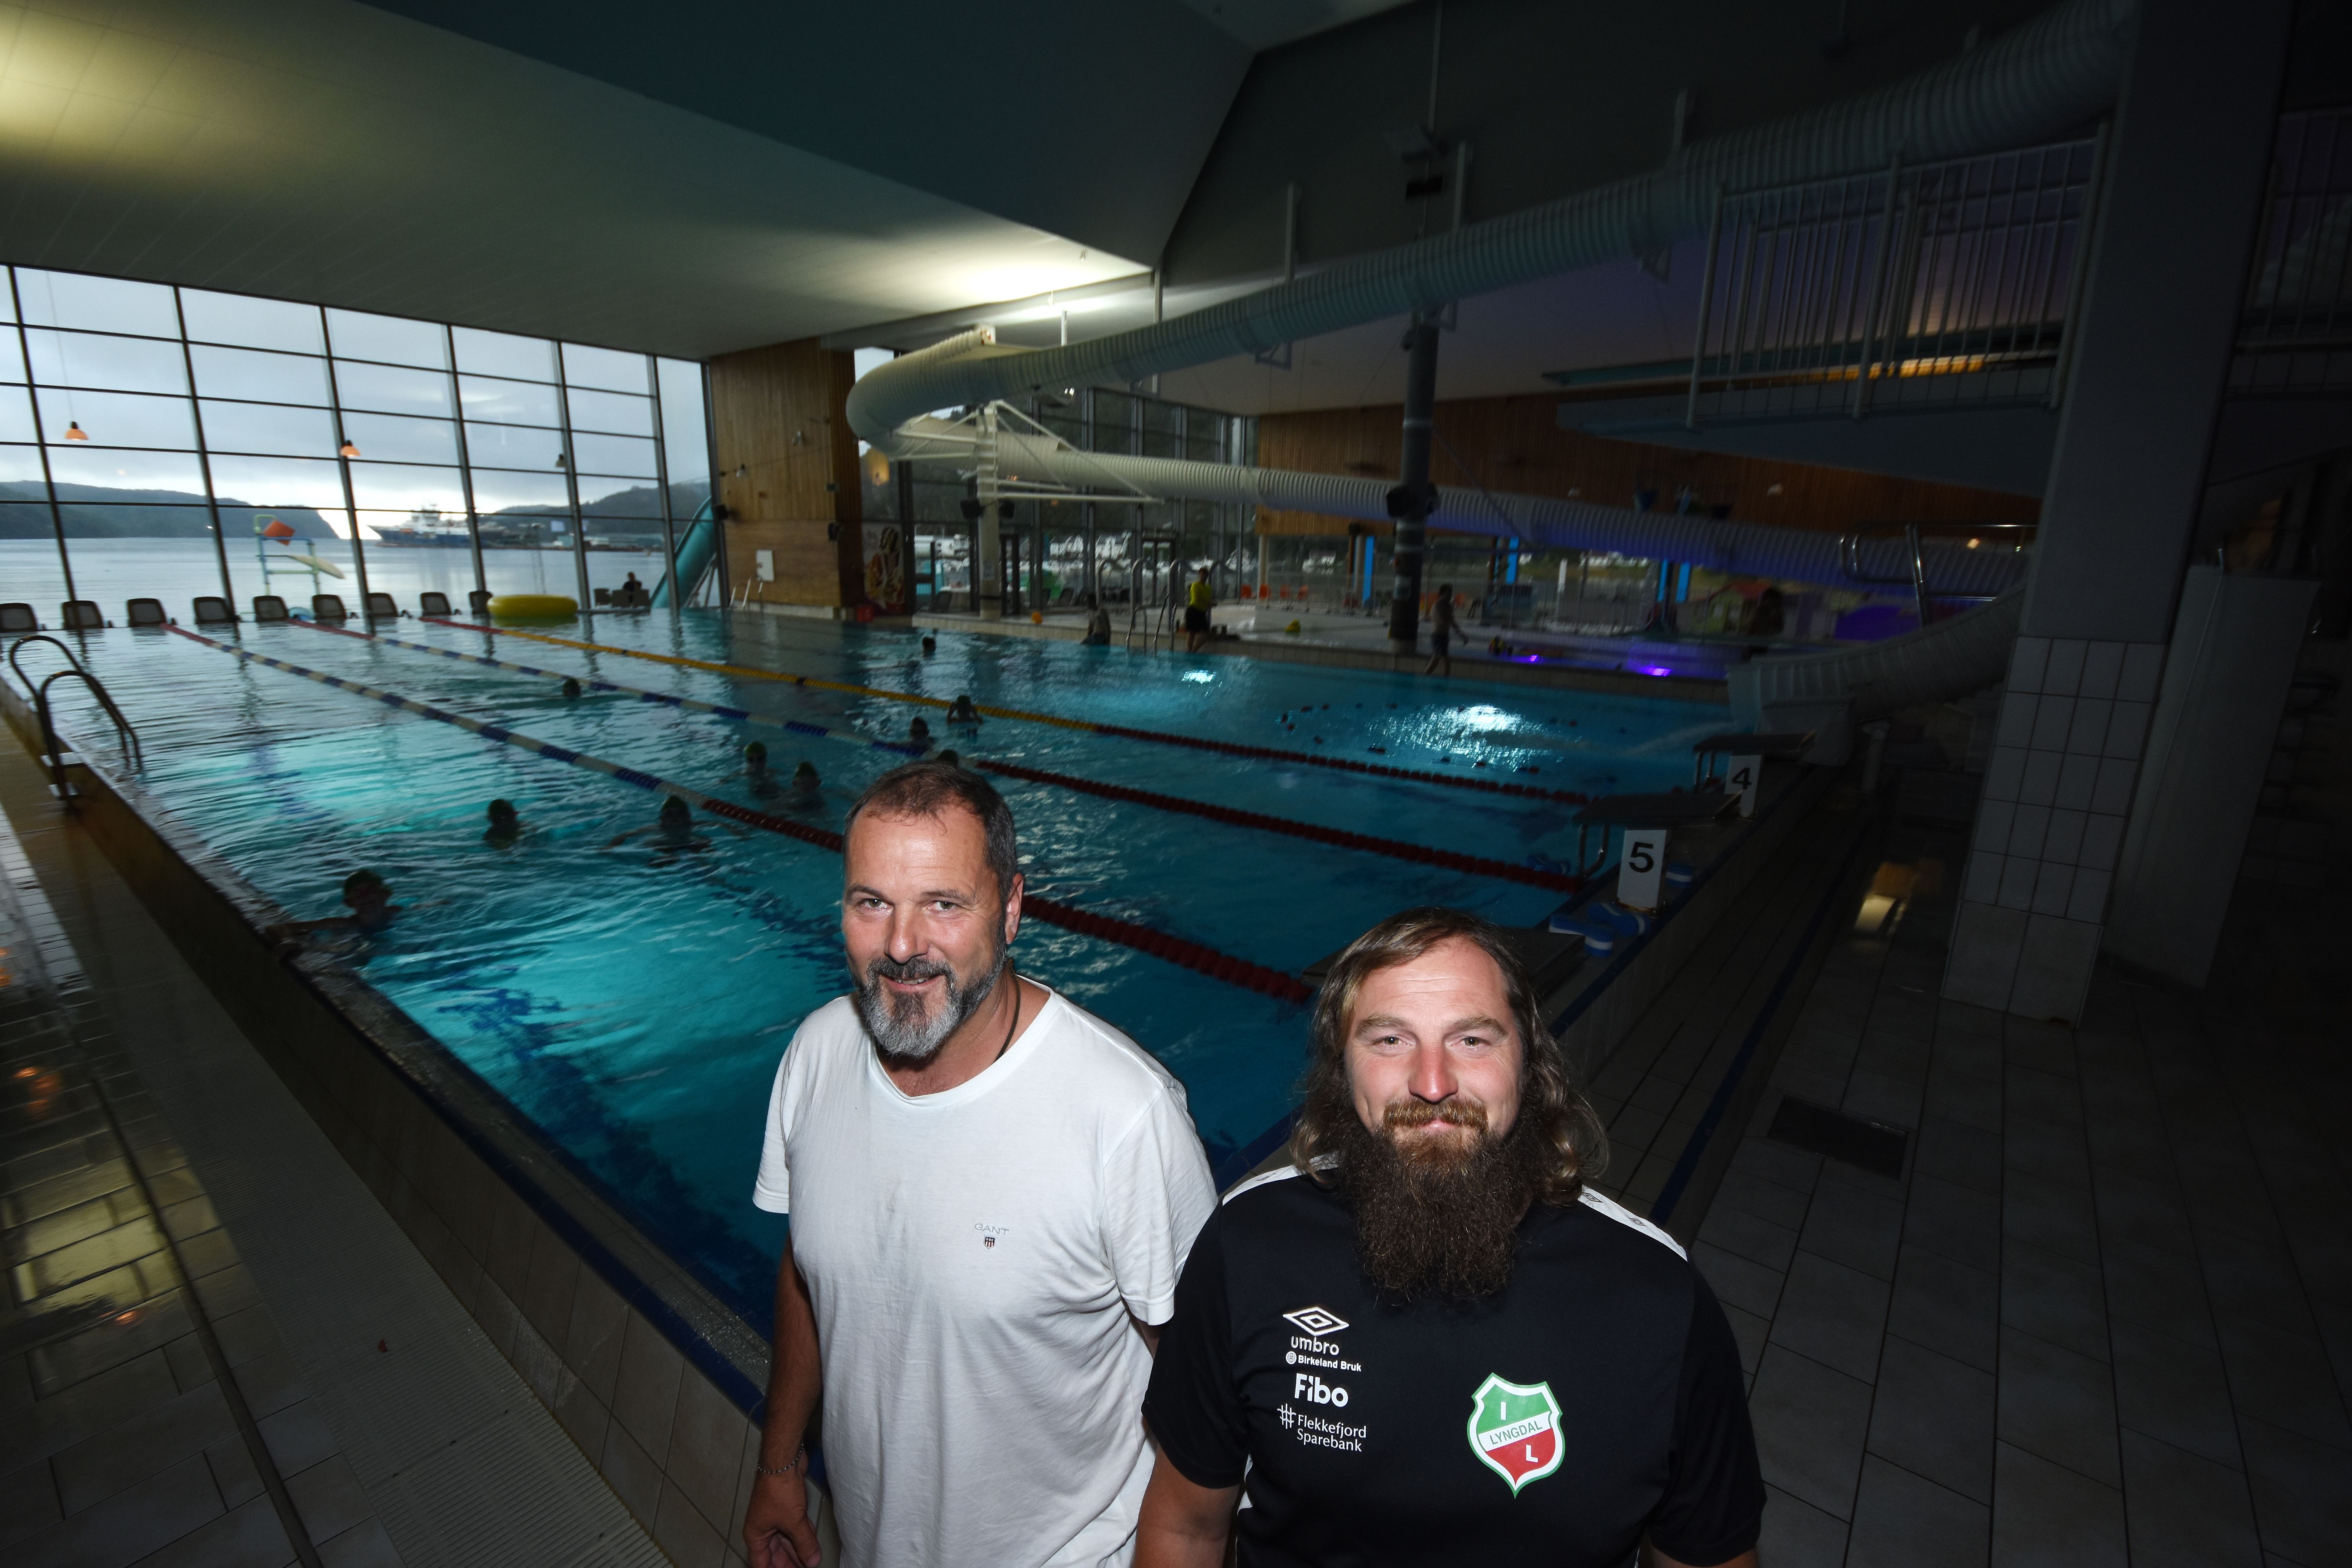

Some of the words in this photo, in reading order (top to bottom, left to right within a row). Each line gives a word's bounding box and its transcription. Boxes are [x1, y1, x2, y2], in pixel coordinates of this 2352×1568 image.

[1732, 767, 1752, 790] 4
[1629, 842, 1654, 873] 5
[975, 1223, 1010, 1235] GANT
[1290, 1336, 1339, 1356] umbro
[1298, 1355, 1338, 1368] Birkeland
[1340, 1361, 1361, 1372] Bruk
[1294, 1373, 1348, 1407] Fibo
[1298, 1414, 1367, 1439] Flekkefjord
[1489, 1420, 1543, 1445] LYNGDAL
[1297, 1428, 1362, 1452] Sparebank
[1526, 1445, 1539, 1463] L
